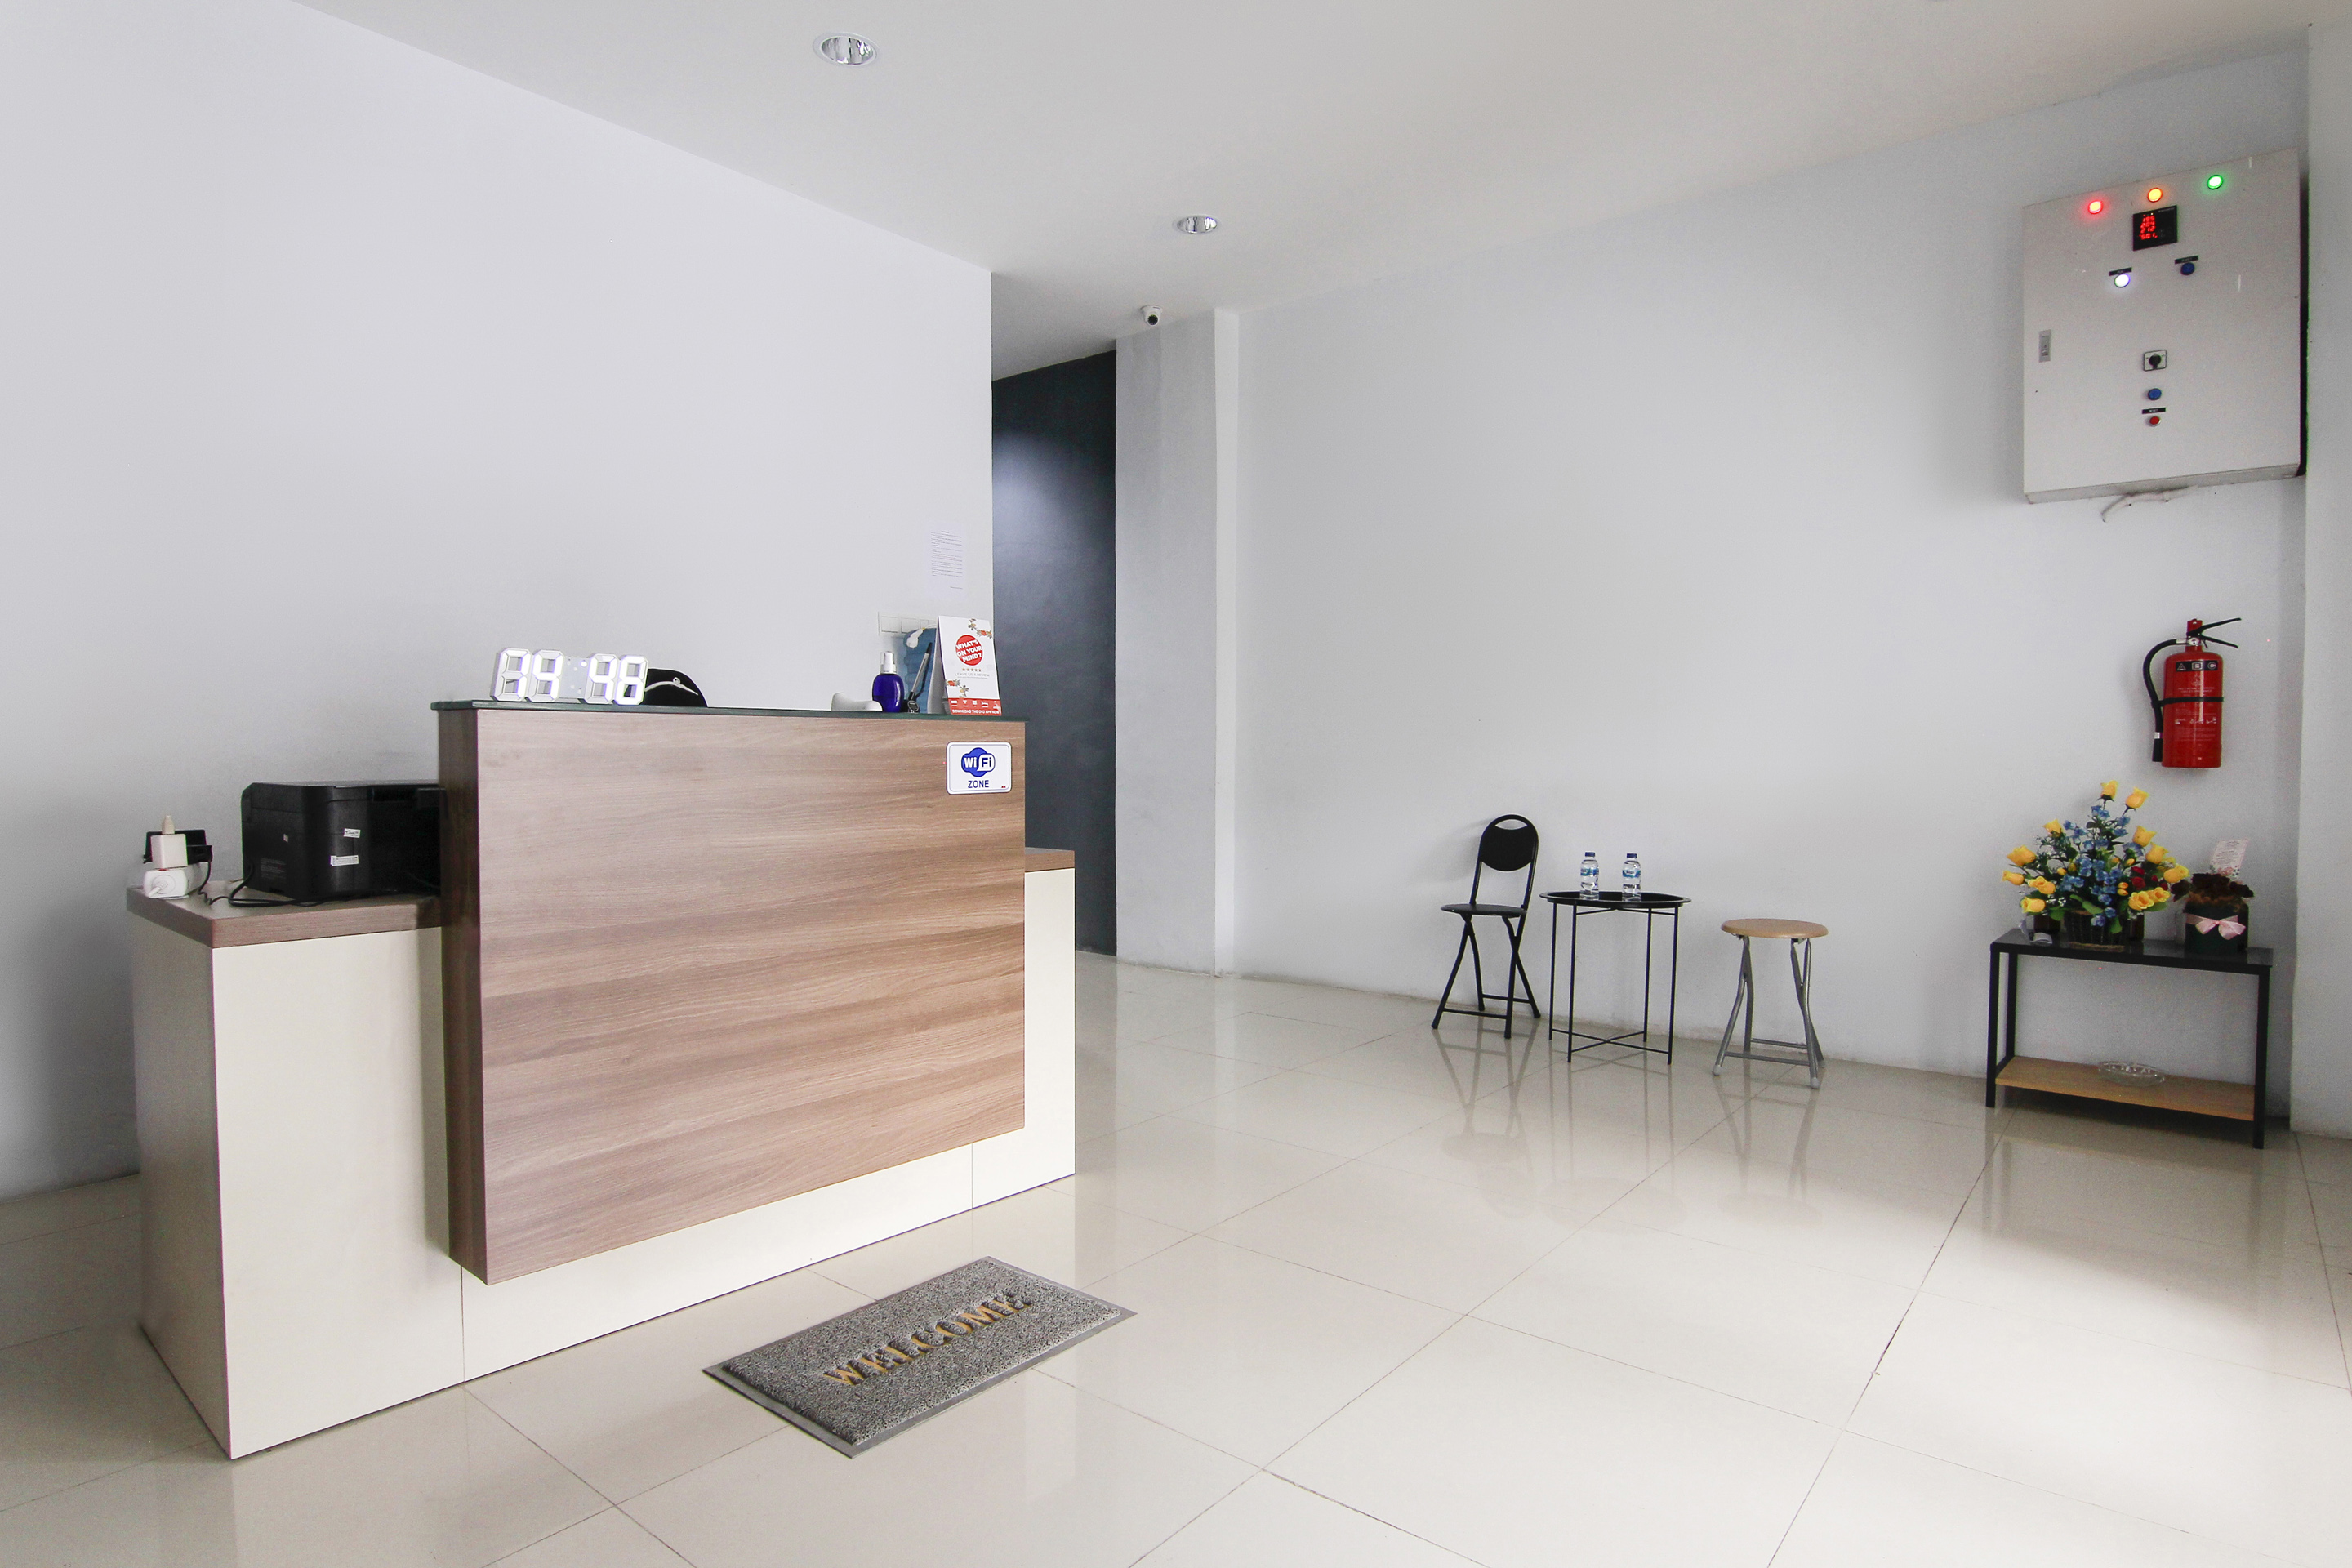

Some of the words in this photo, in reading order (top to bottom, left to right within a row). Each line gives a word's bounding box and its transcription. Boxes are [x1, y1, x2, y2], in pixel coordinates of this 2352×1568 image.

[956, 639, 978, 649] WHAT'S
[966, 645, 982, 654] YOUR
[962, 653, 982, 662] MIND?
[964, 756, 992, 768] WiFi
[967, 779, 990, 789] ZONE
[822, 1290, 1033, 1386] WELCOME
